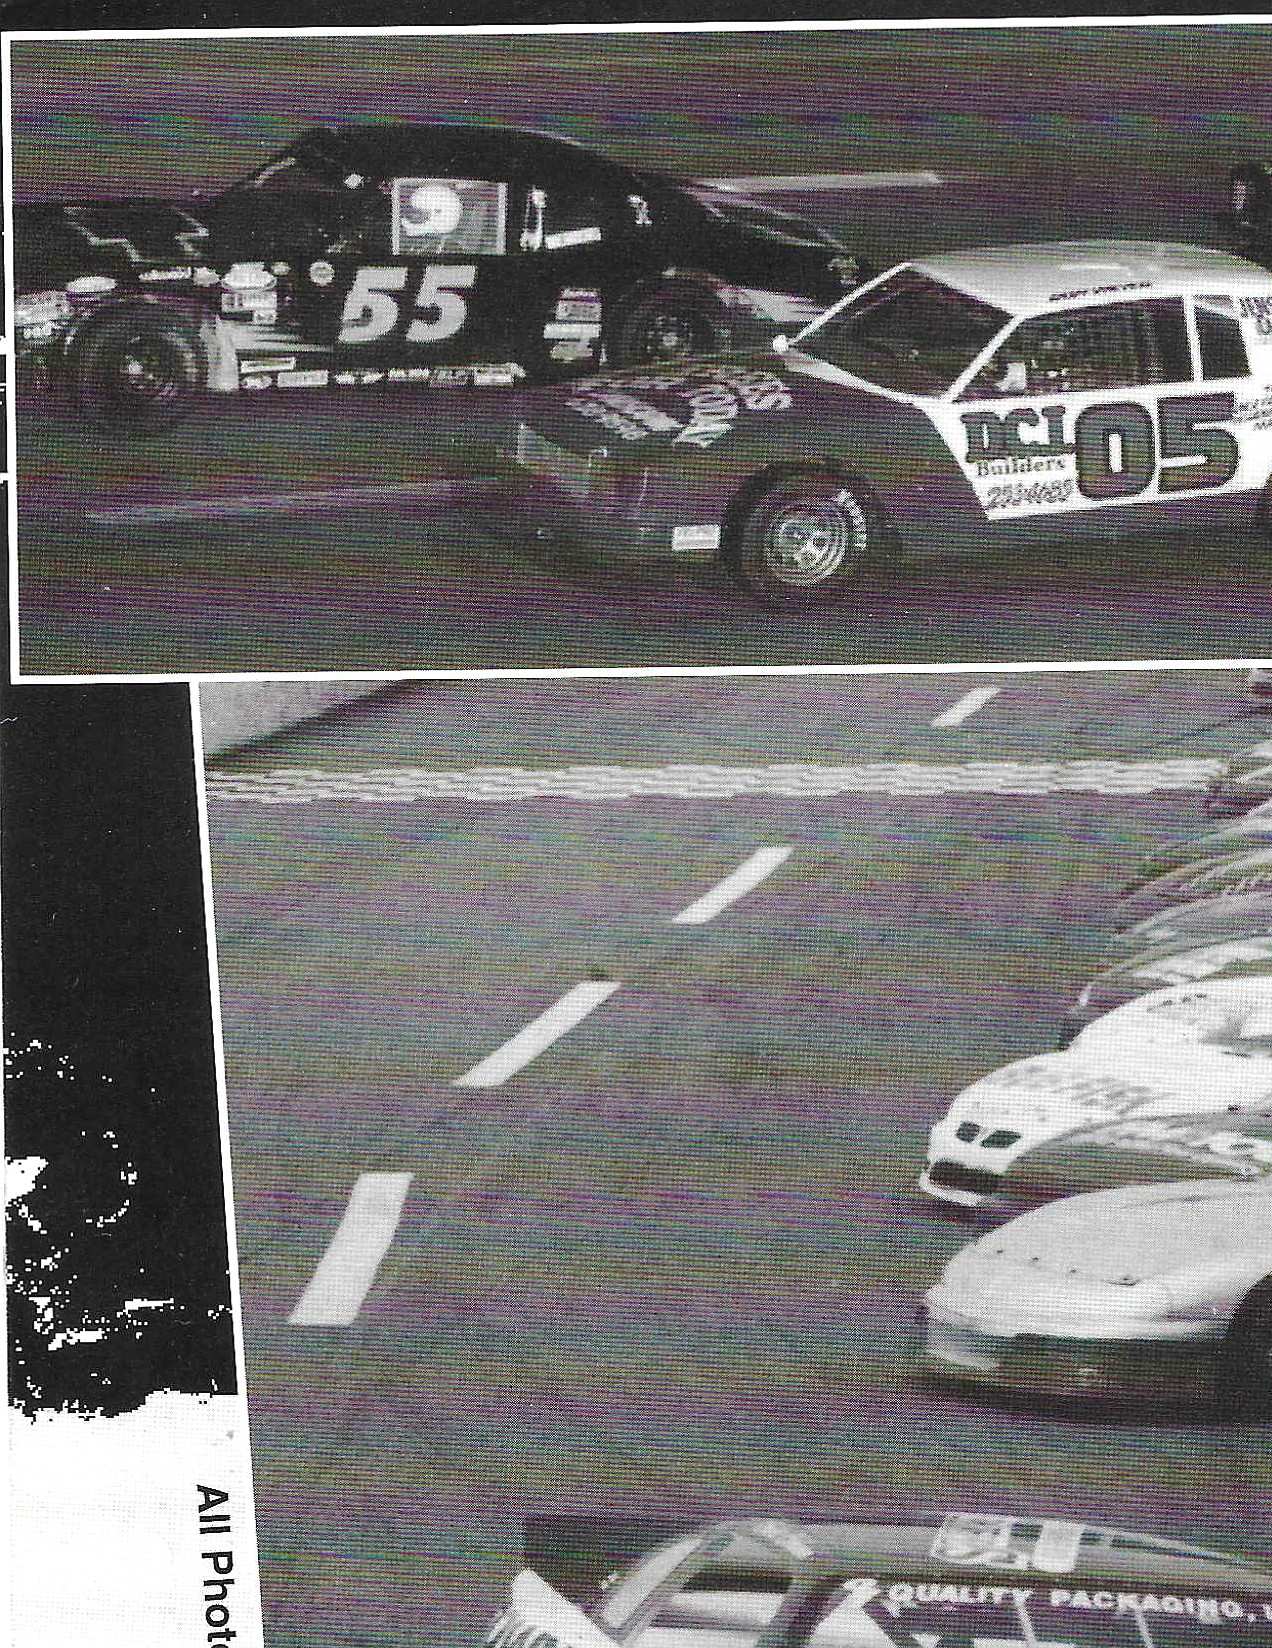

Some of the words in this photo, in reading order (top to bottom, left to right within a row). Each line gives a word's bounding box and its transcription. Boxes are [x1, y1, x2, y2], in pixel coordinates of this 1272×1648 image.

[338, 264, 479, 345] 55
[977, 456, 1066, 477] Builders
[1075, 391, 1240, 501] 05
[888, 1581, 1033, 1606] QUALITY
